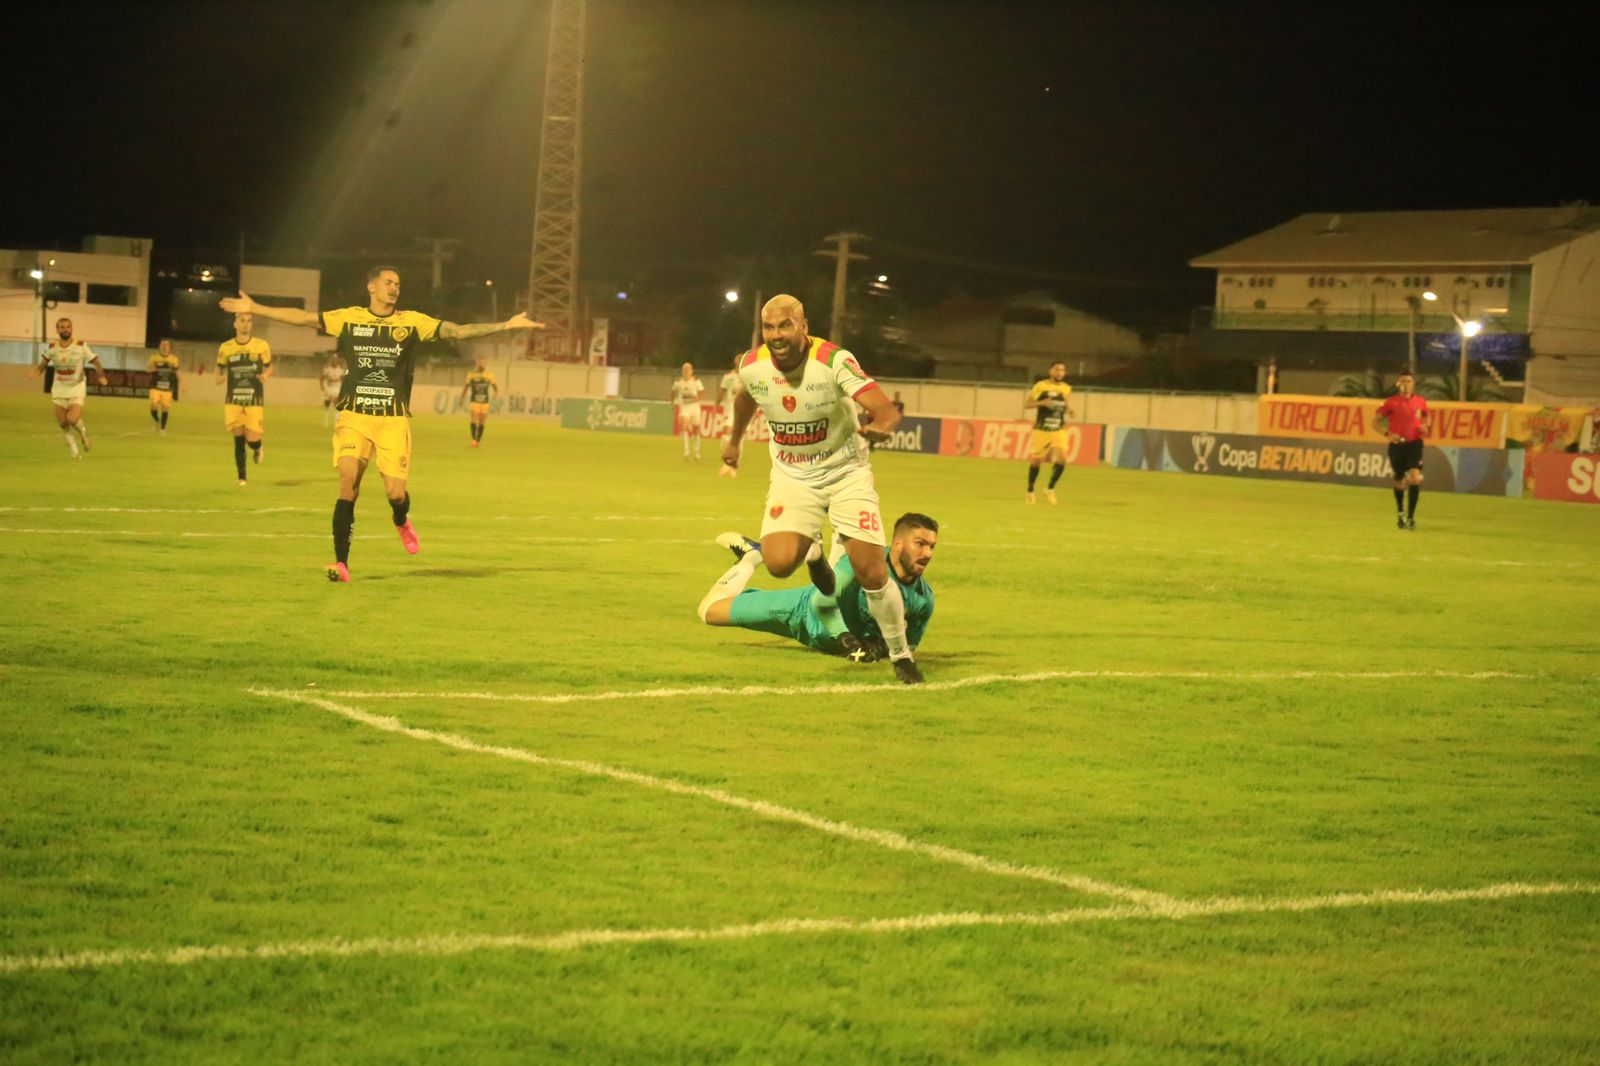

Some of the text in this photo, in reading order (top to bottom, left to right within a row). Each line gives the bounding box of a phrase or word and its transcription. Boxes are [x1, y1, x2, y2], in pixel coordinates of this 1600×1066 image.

[353, 345, 397, 353] MANTOVANI
[603, 405, 649, 429] Sicredi
[1268, 401, 1365, 436] TORCIDA
[873, 424, 922, 450] onal
[978, 422, 1082, 463] BETAO
[1219, 443, 1394, 478] Copa BETANO do BRA
[858, 510, 880, 532] 26
